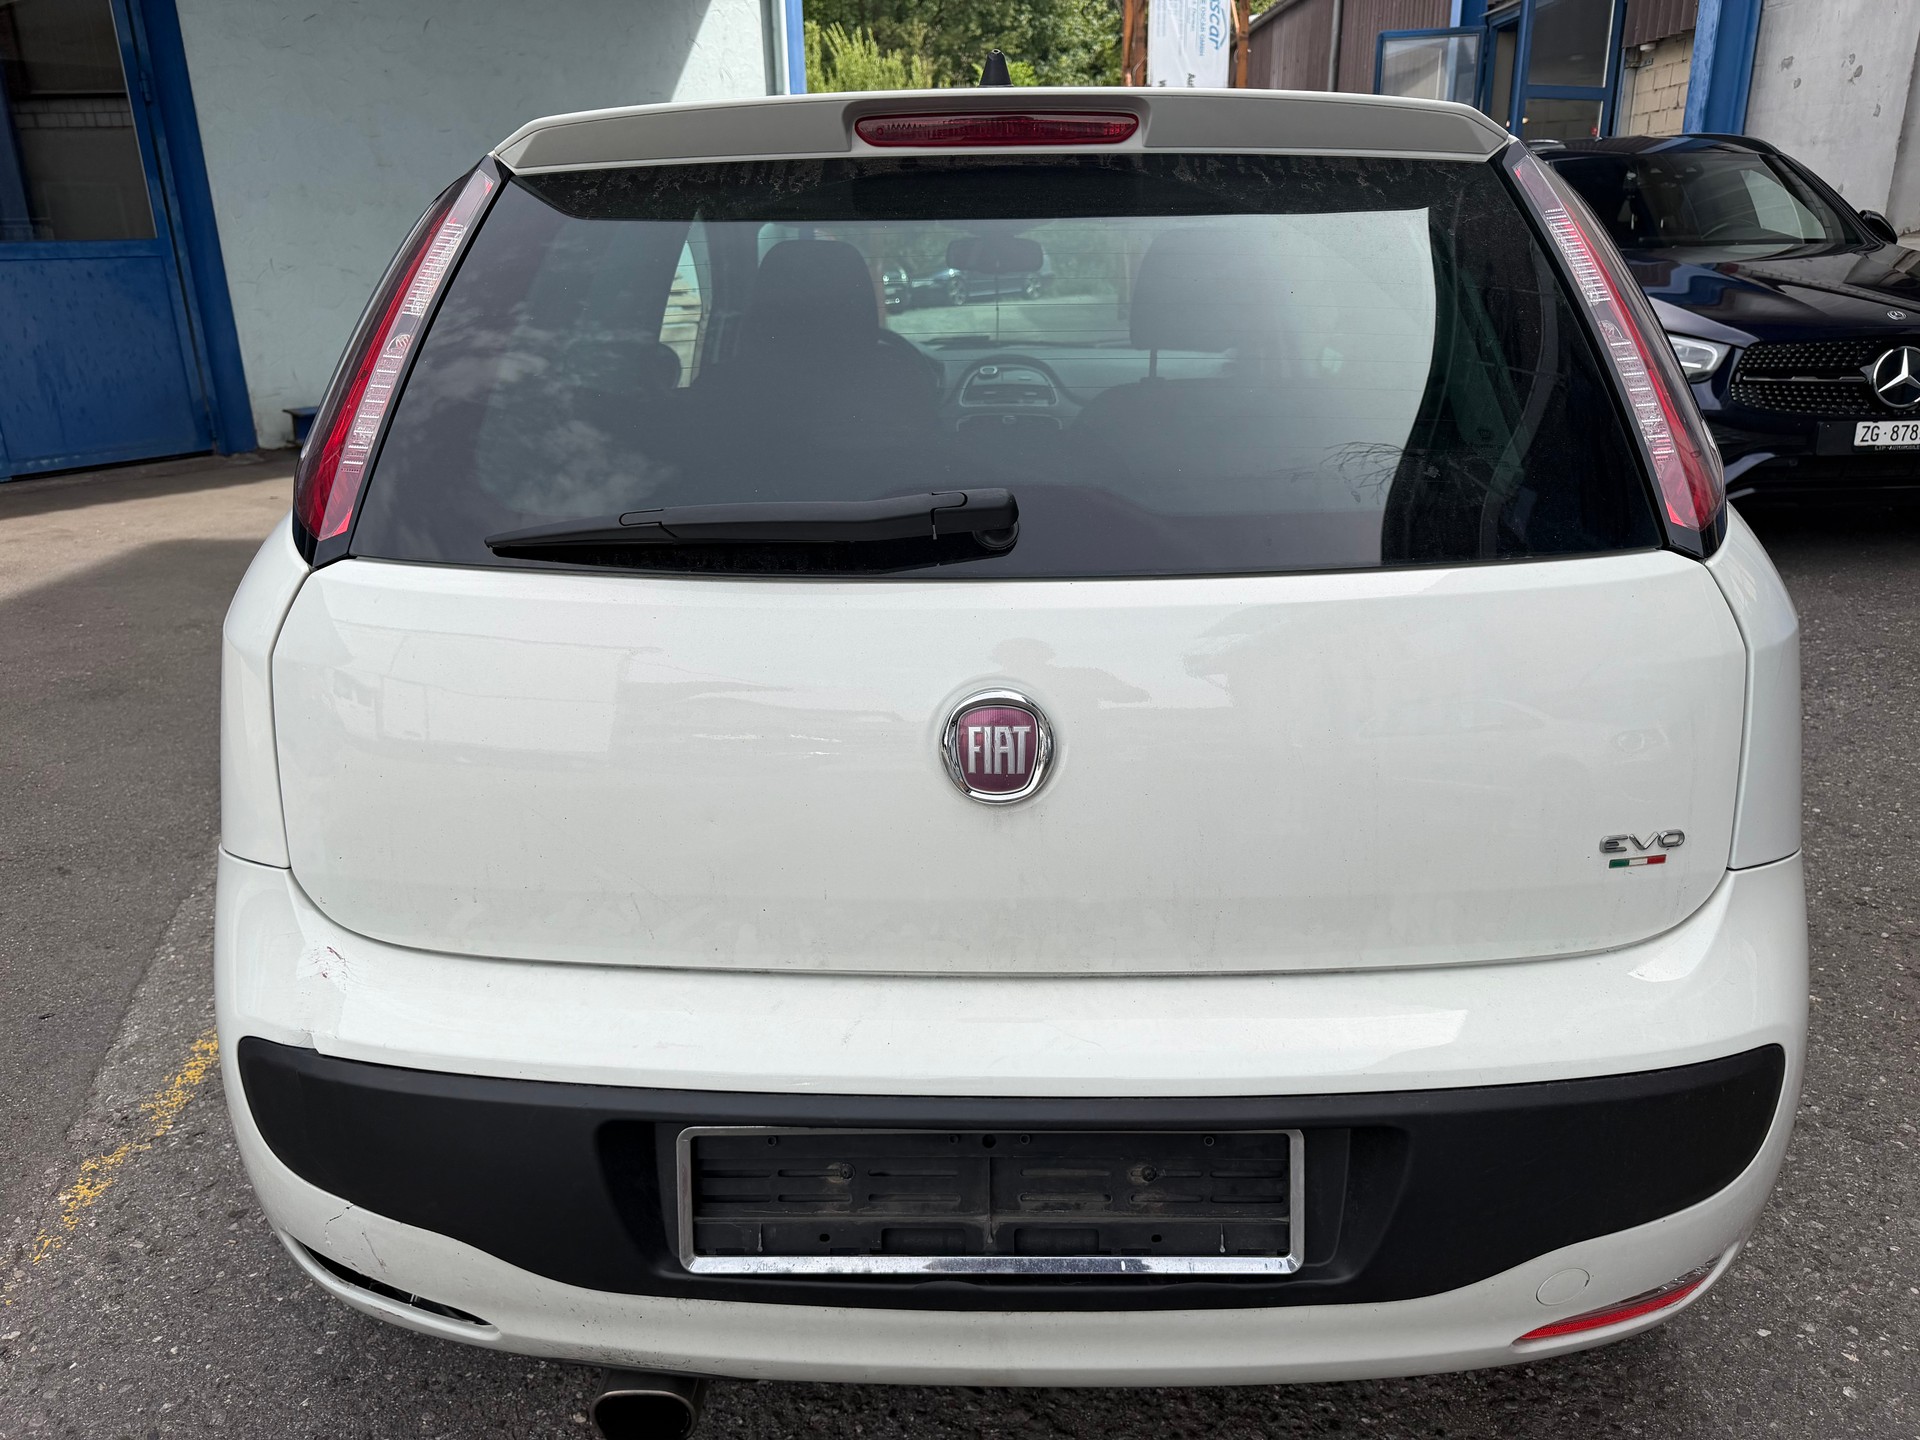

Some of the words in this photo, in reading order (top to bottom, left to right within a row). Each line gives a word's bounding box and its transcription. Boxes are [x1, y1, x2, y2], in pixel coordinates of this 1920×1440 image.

[1209, 0, 1221, 50] scar
[968, 726, 1031, 775] FIAT
[1599, 828, 1685, 853] EVO
